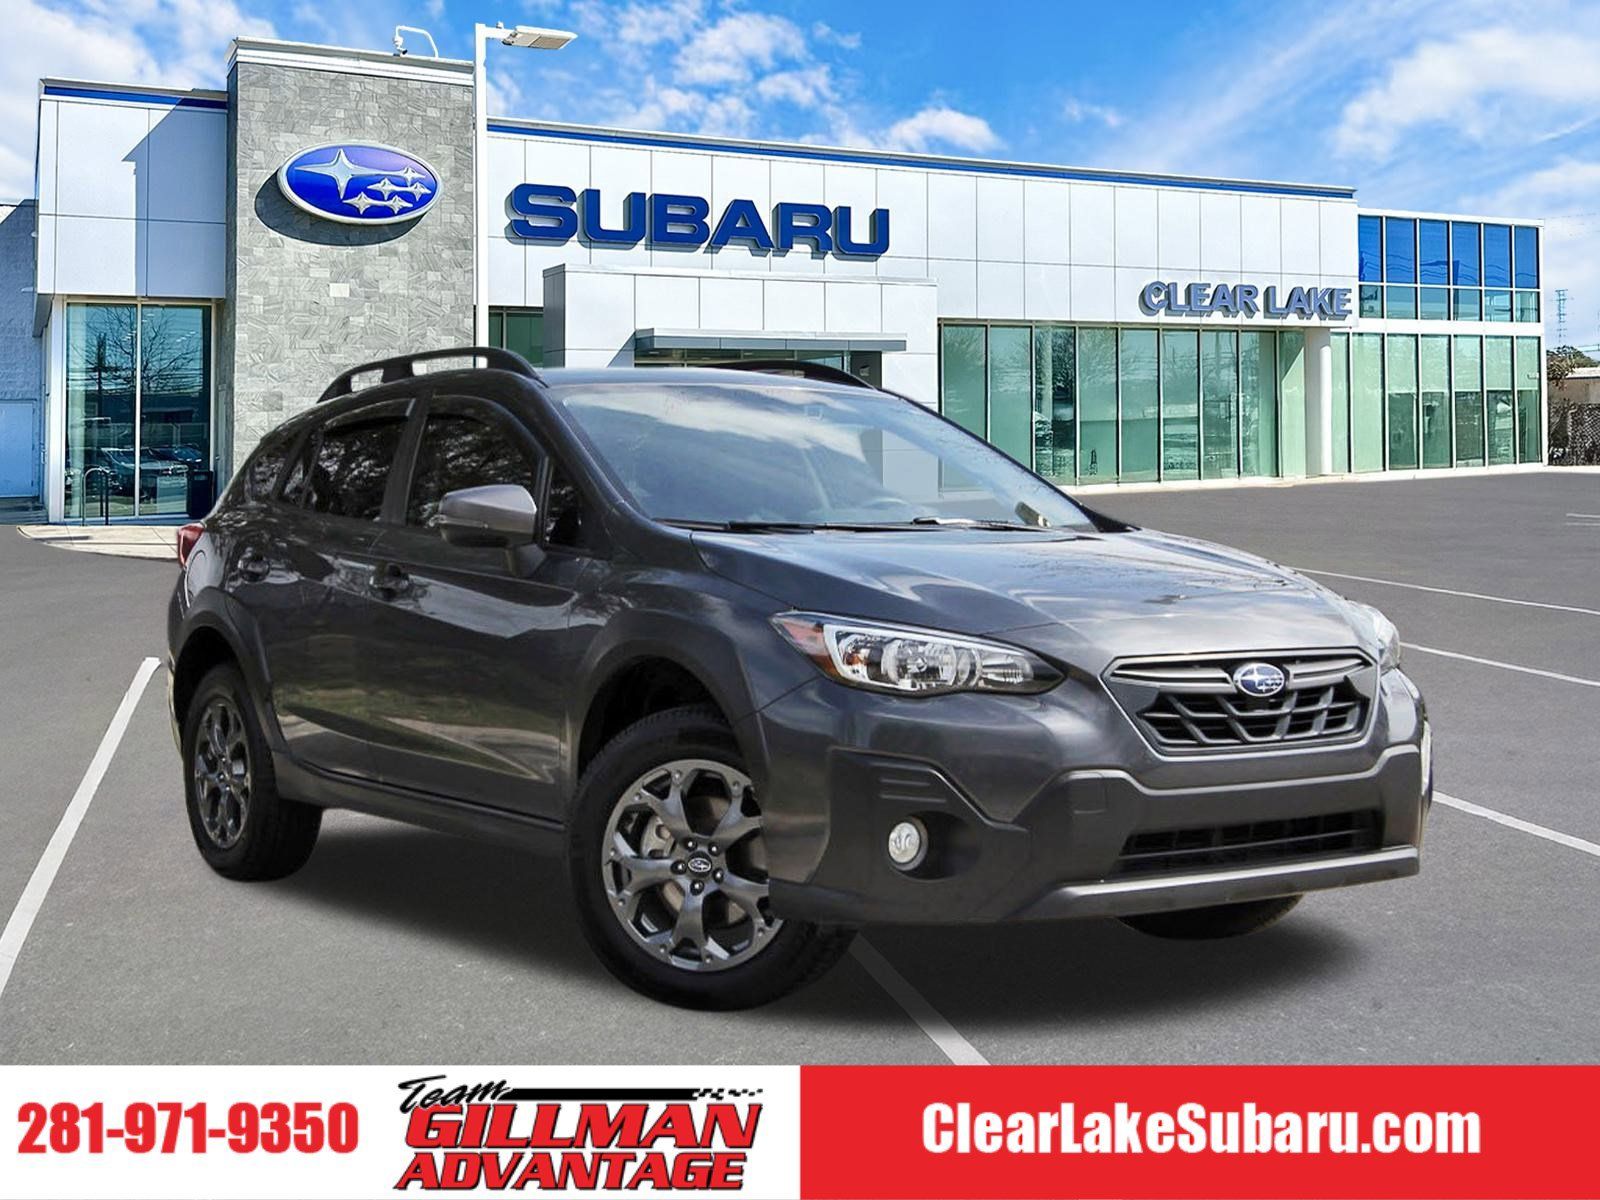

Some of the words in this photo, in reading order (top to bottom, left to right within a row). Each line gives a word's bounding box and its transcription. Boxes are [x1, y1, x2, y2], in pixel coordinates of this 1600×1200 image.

[506, 183, 890, 260] SUBARU
[1140, 281, 1260, 317] CLEAR
[1264, 285, 1353, 320] LAKE
